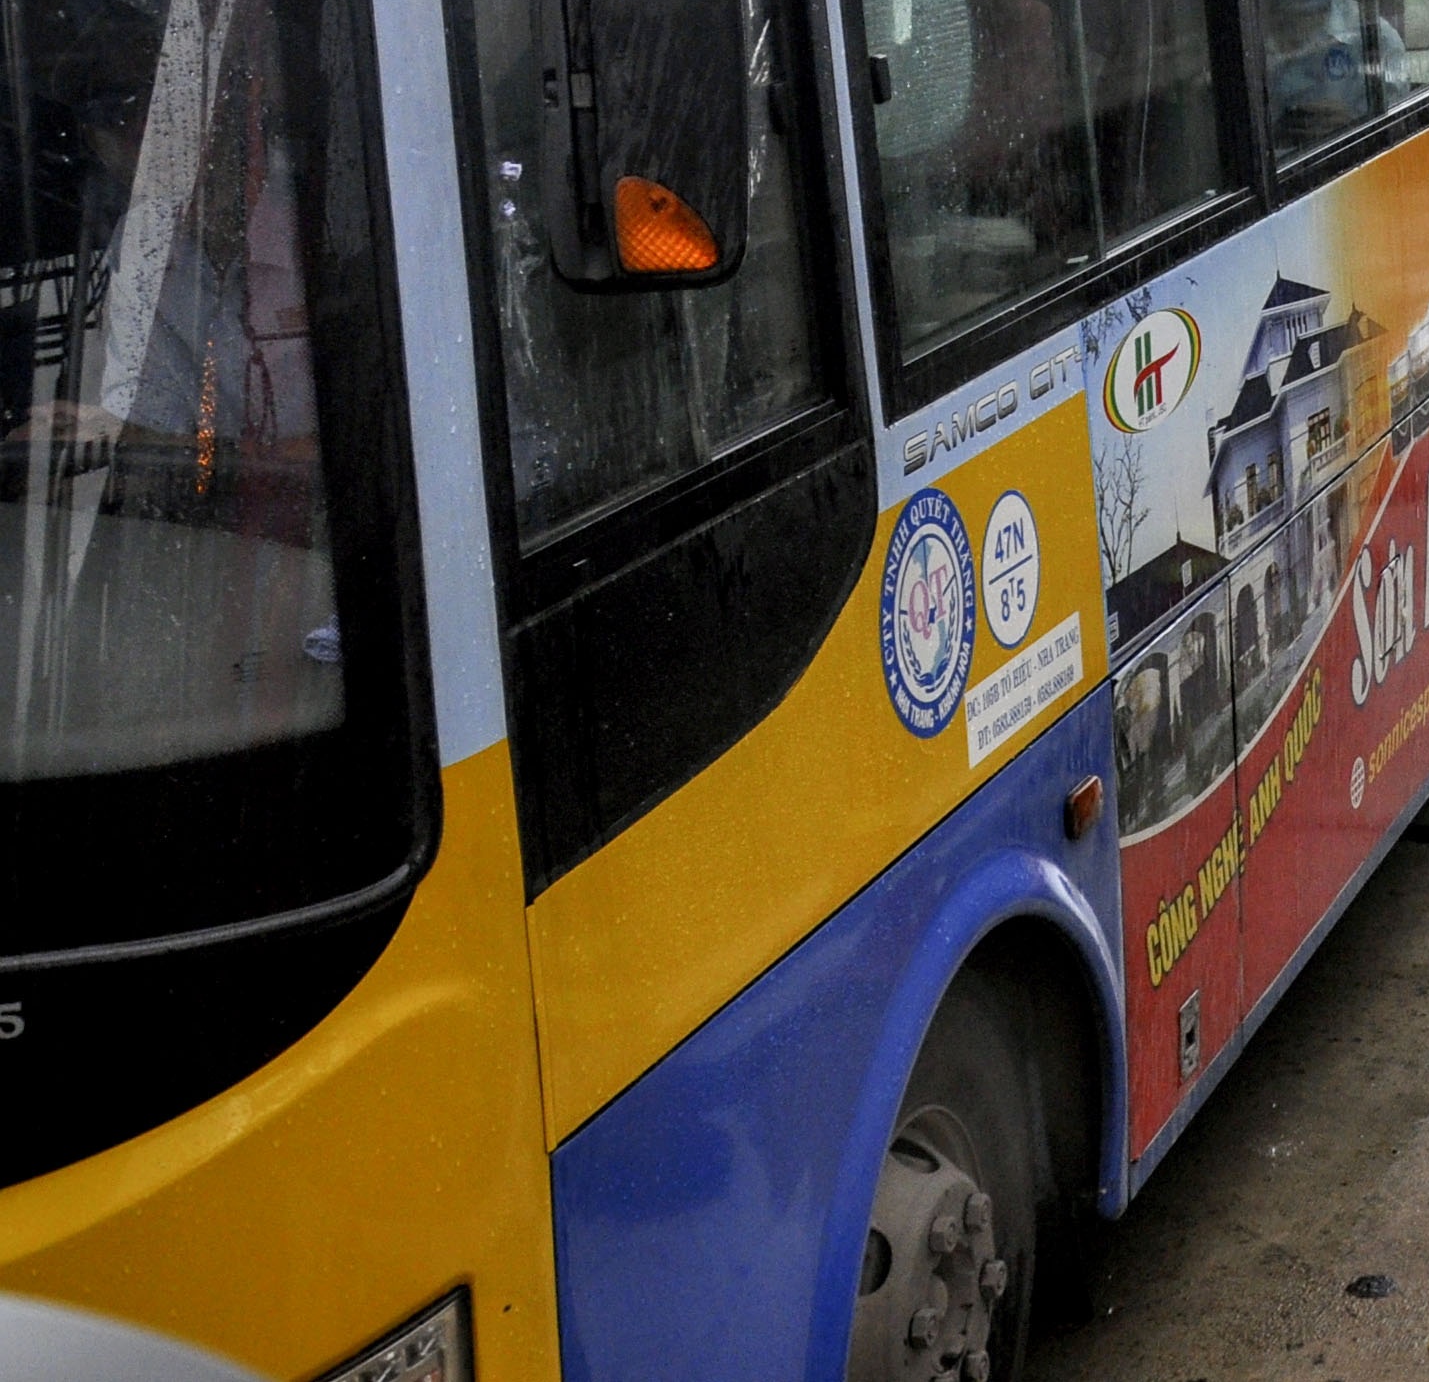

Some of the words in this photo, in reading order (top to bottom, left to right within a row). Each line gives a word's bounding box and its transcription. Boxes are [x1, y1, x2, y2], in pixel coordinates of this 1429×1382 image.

[903, 379, 1020, 477] SAMCO
[910, 493, 950, 527] QUYẾT
[994, 517, 1025, 563] 47N
[884, 521, 908, 596] TNHH
[952, 517, 974, 602] THẮNG
[883, 608, 894, 665] CTY
[908, 564, 950, 640] QT
[1146, 881, 1198, 987] CÔNG
[1197, 809, 1246, 920] NGHỆ
[1249, 752, 1282, 849] ANH
[1283, 665, 1323, 783] QUỐC
